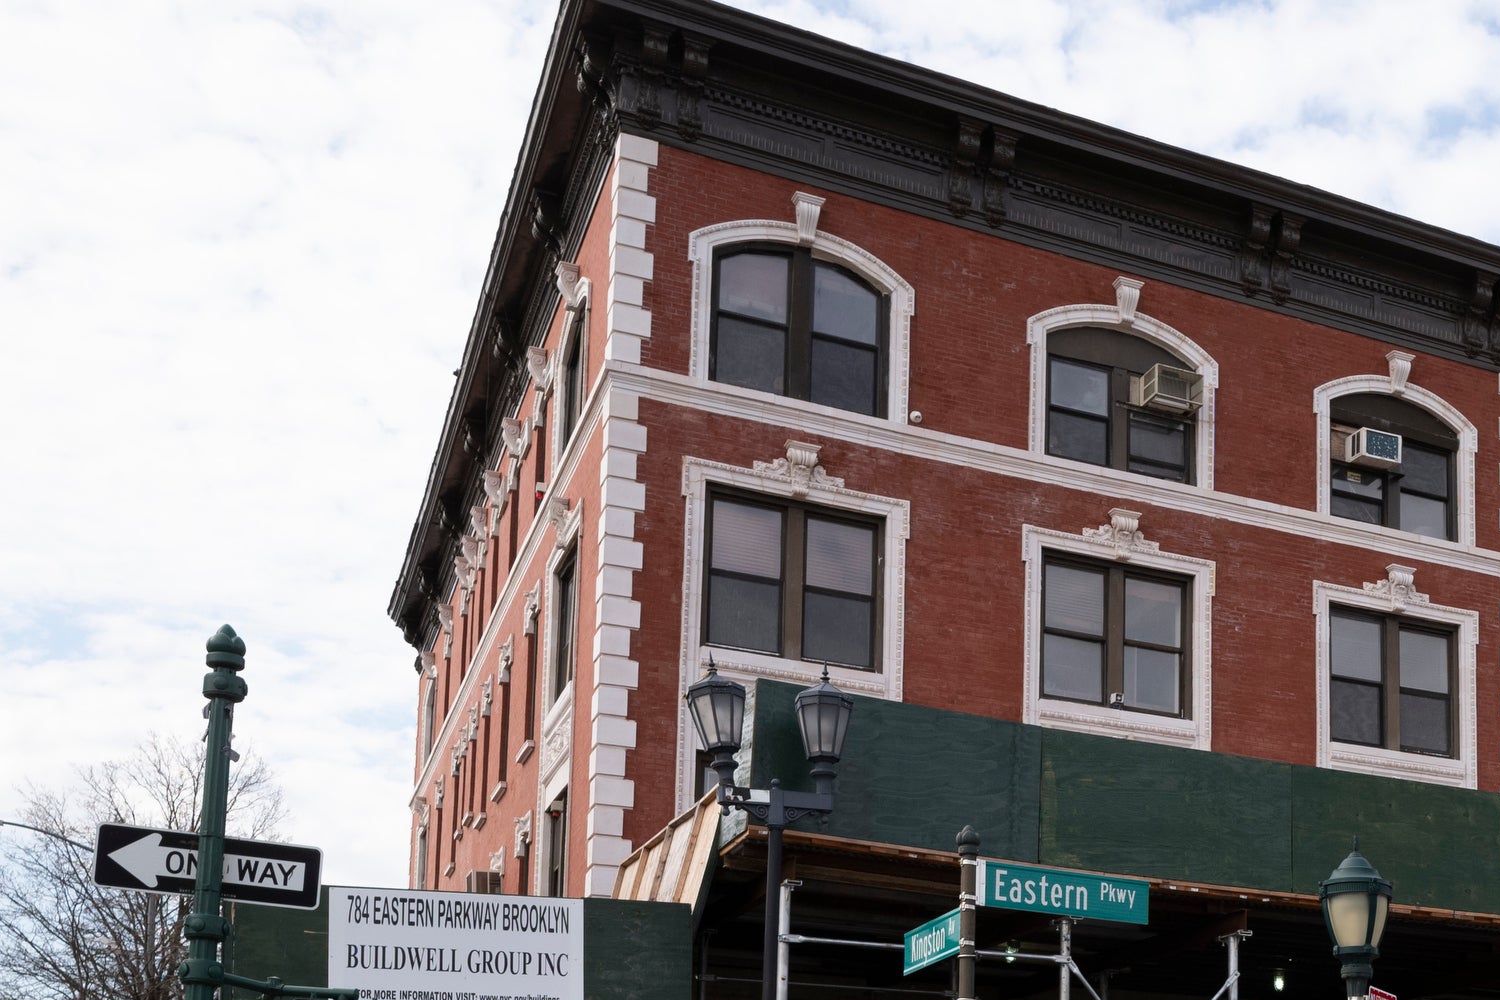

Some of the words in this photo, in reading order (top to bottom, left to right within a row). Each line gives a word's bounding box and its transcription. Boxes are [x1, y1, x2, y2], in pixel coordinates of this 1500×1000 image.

[165, 851, 224, 879] ON
[237, 858, 298, 887] WAY
[995, 869, 1088, 911] Eastern
[1100, 882, 1136, 909] Pkwy
[347, 895, 369, 924] 784
[373, 896, 434, 928] EASTERN
[438, 901, 500, 931] PARKWAY
[503, 904, 569, 934] BROOKLYN
[347, 944, 462, 973] BUILDWELL
[467, 949, 532, 976] GROUP
[536, 952, 569, 977] INC
[911, 926, 945, 966] Kingston
[374, 990, 397, 1000] MORE
